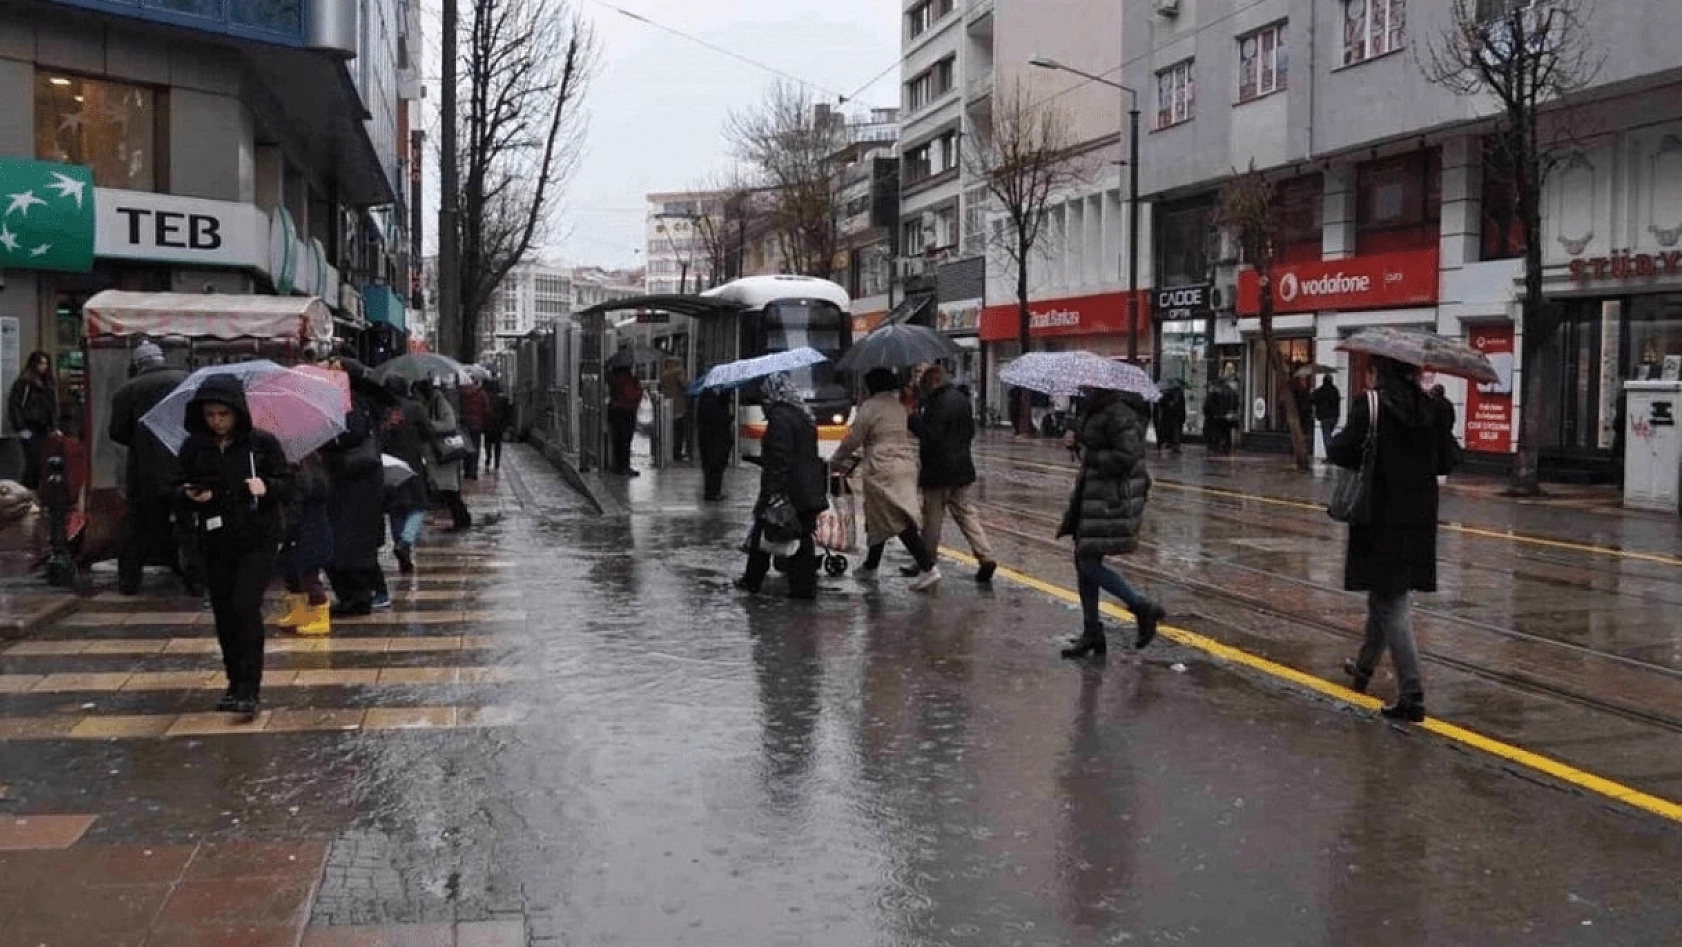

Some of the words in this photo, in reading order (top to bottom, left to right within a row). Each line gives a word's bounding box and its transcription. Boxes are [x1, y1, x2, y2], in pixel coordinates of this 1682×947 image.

[116, 206, 222, 250] TEB
[1301, 272, 1371, 295] vodafone
[1159, 289, 1203, 308] CADDE
